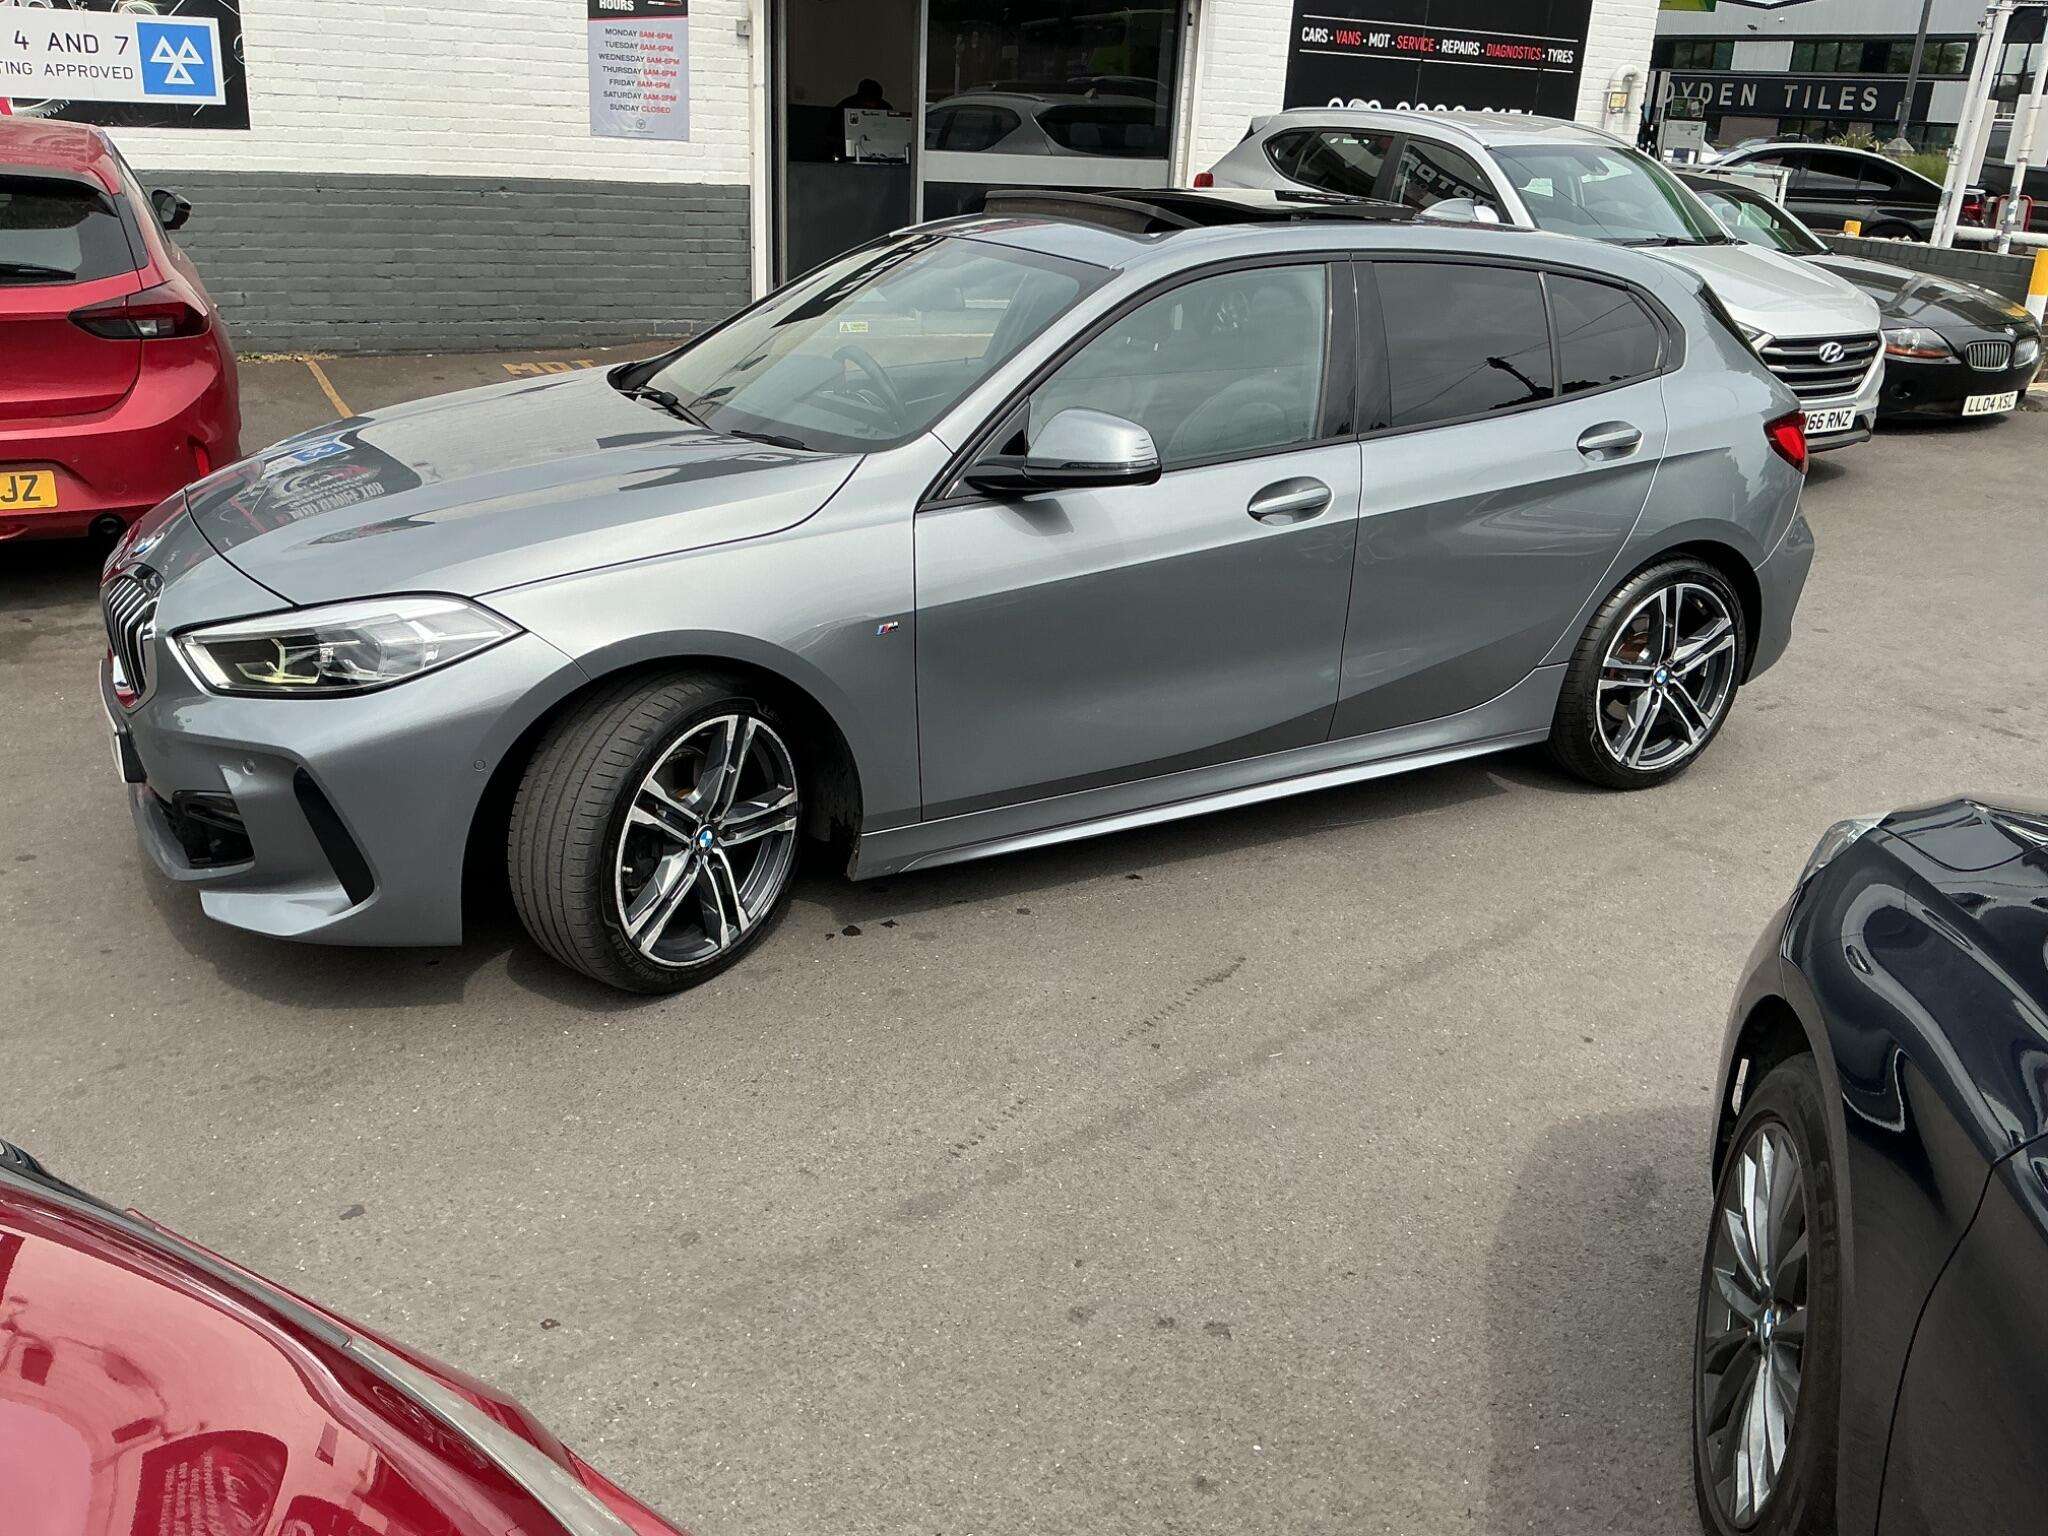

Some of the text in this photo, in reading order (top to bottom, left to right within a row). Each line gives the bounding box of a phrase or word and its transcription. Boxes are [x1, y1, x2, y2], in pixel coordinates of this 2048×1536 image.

[599, 0, 634, 11] HOURS
[605, 28, 637, 37] MONDAY
[14, 30, 129, 55] 4 AND 7
[605, 41, 639, 50] TUESDAY
[1301, 26, 1574, 64] CARS VANS MOT SERVICE REPAIRS DIAGNOSTICS TYRES
[598, 53, 645, 63] WEDNESDAY
[43, 63, 134, 80] APPROVED
[602, 65, 642, 75] THURSDAY
[609, 78, 636, 87] FRIDAY
[603, 90, 641, 100] SATURDAY
[1783, 83, 1880, 113] TILES
[609, 103, 671, 114] SUNDAY CLOSED
[502, 359, 595, 375] MOT
[1826, 410, 1852, 428] RNZ
